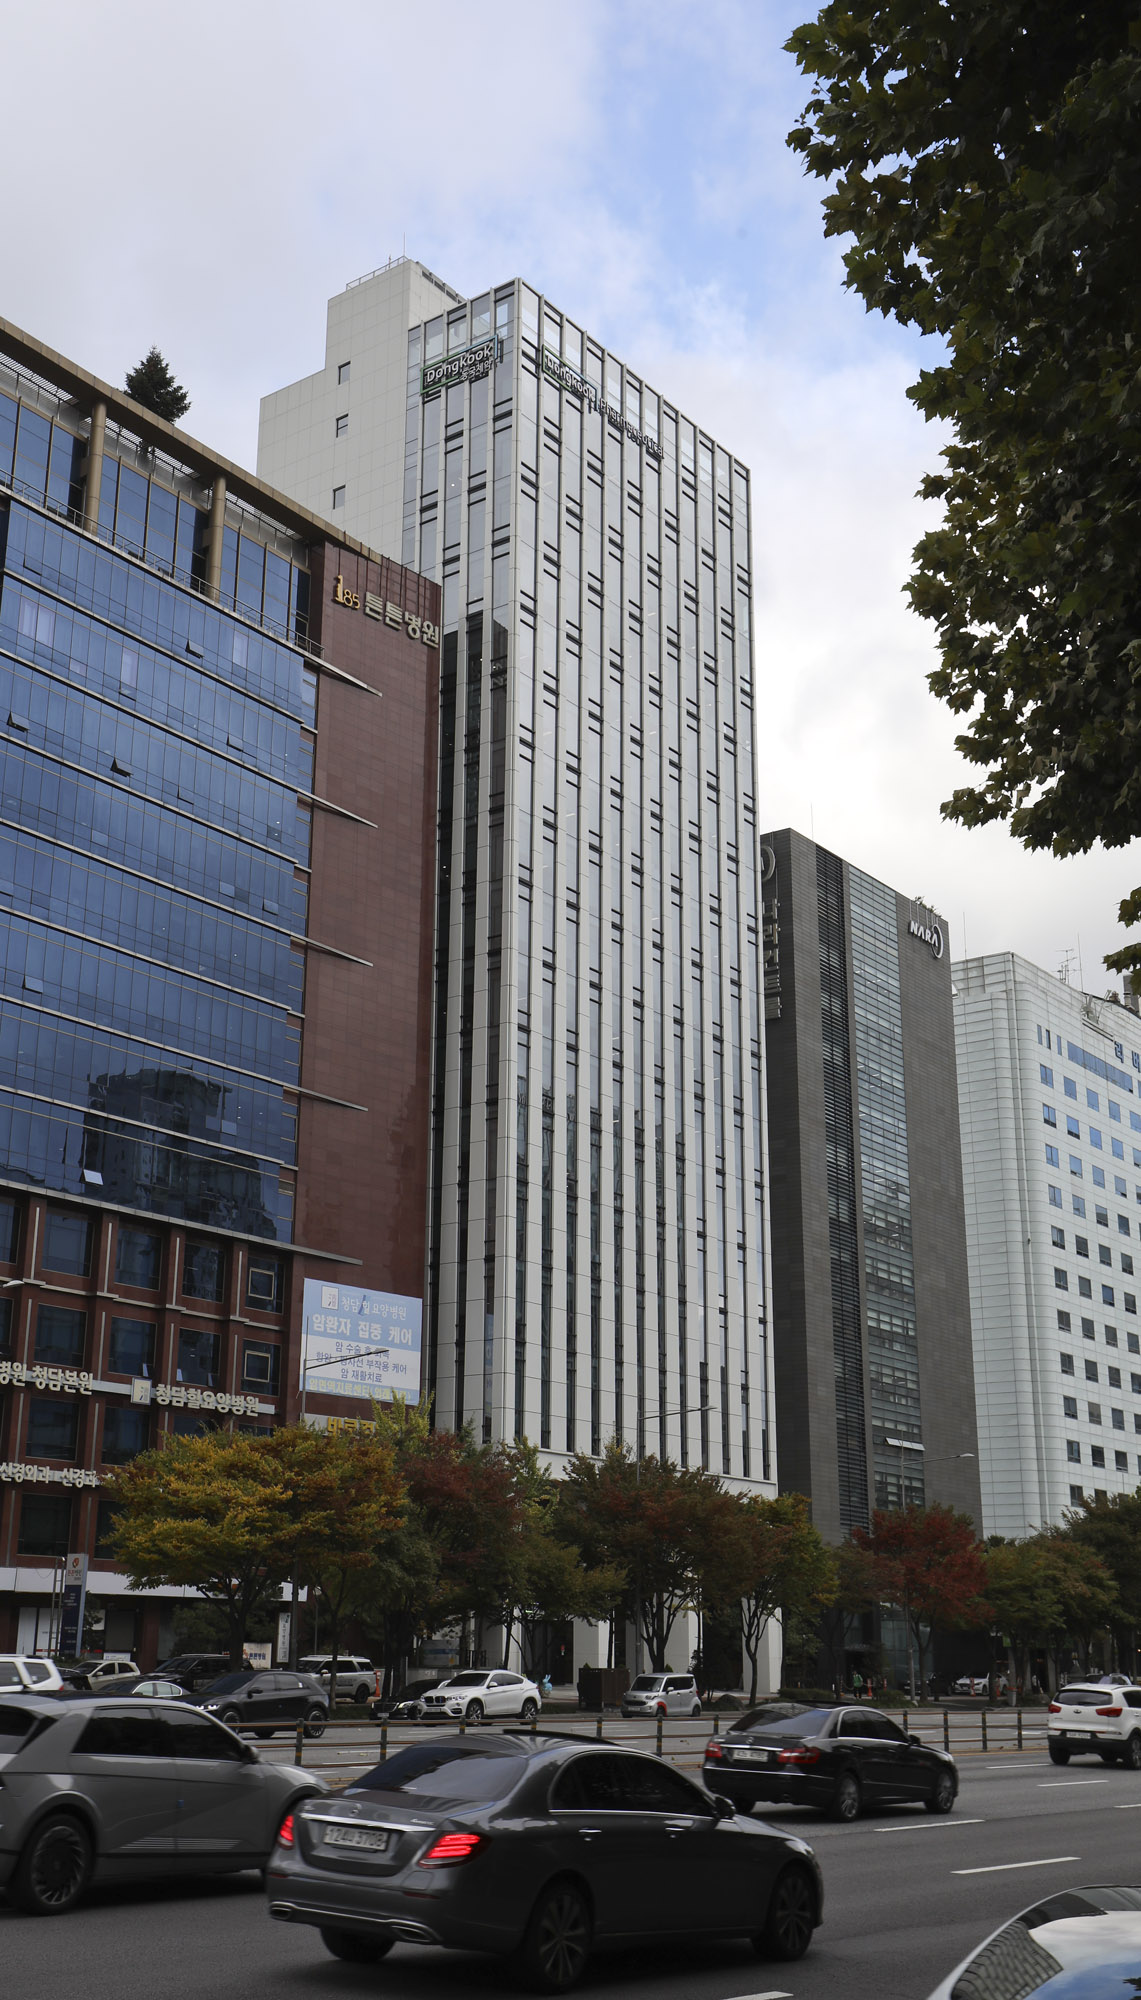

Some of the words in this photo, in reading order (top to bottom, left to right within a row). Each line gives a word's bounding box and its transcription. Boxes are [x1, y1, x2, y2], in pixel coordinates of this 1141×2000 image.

[427, 344, 493, 383] Dongkook
[459, 359, 494, 381] 동국제약
[546, 355, 596, 402] Dongkook
[365, 591, 439, 648] 든든병원
[909, 920, 939, 947] NARA
[372, 1303, 407, 1320] 요양병원
[312, 1313, 351, 1336] 암환자
[358, 1321, 383, 1341] 집중
[388, 1326, 412, 1346] 케어
[335, 1341, 343, 1352] 암
[346, 1343, 361, 1355] 수술
[32, 1365, 94, 1395] 청담본원
[341, 1368, 349, 1379] 암
[351, 1369, 383, 1383] 재활치료
[366, 1359, 389, 1372] 부작용
[391, 1363, 407, 1375] 케어
[155, 1384, 259, 1417] 청담힐요양병원
[0, 1462, 50, 1484] 신경외과
[61, 1467, 97, 1488] 신경과
